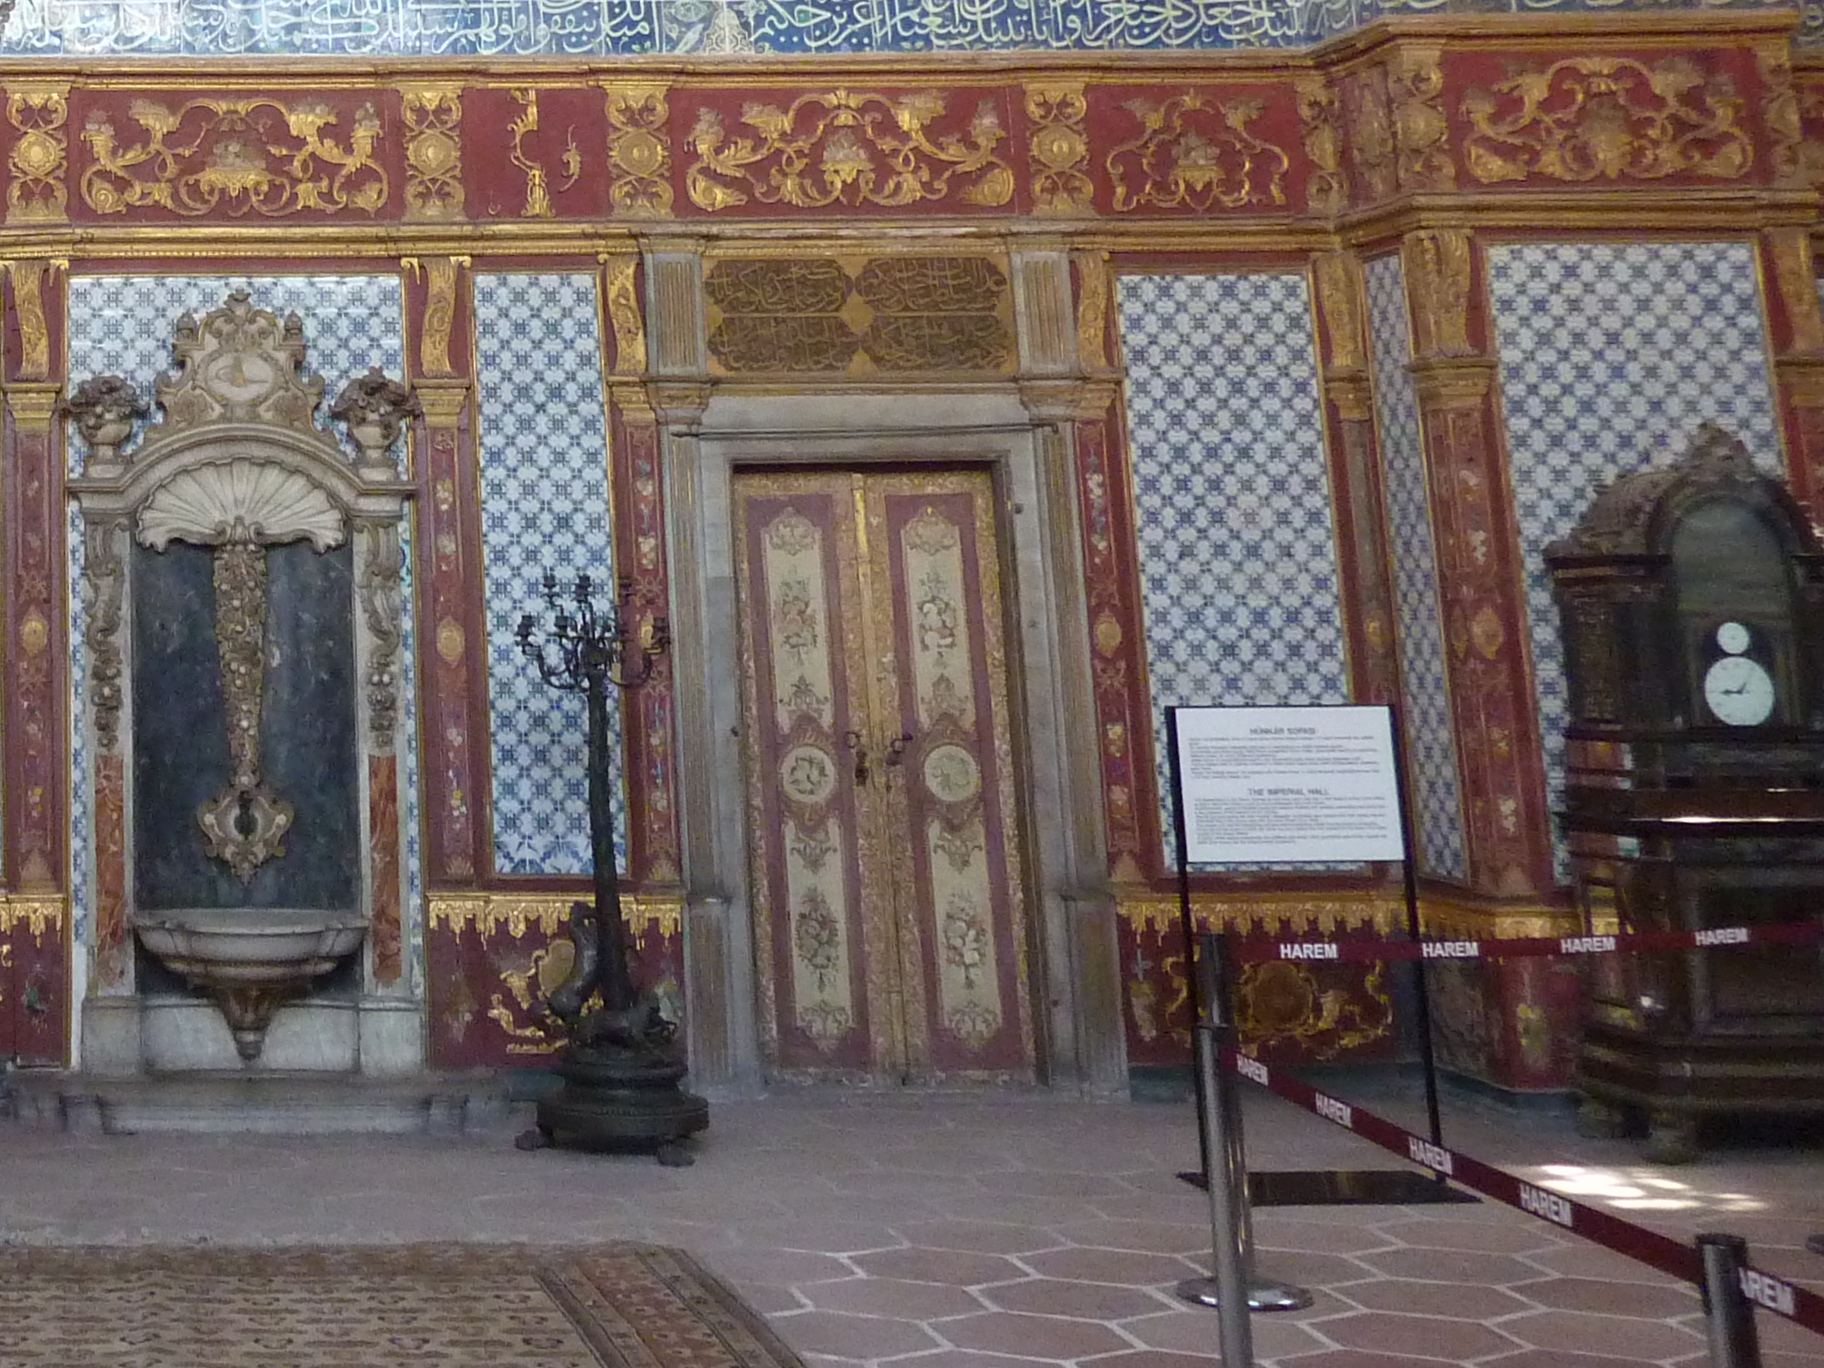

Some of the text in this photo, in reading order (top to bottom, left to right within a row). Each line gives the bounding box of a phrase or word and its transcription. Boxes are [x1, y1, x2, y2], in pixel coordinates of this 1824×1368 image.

[1561, 936, 1616, 953] HAREM
[1694, 927, 1749, 946] HAREM
[1280, 943, 1338, 959] HAREM
[1422, 941, 1479, 958] HAREM
[1315, 1091, 1352, 1128] HAREM
[1408, 1136, 1453, 1175] HAREM
[1519, 1182, 1573, 1227] HAREM
